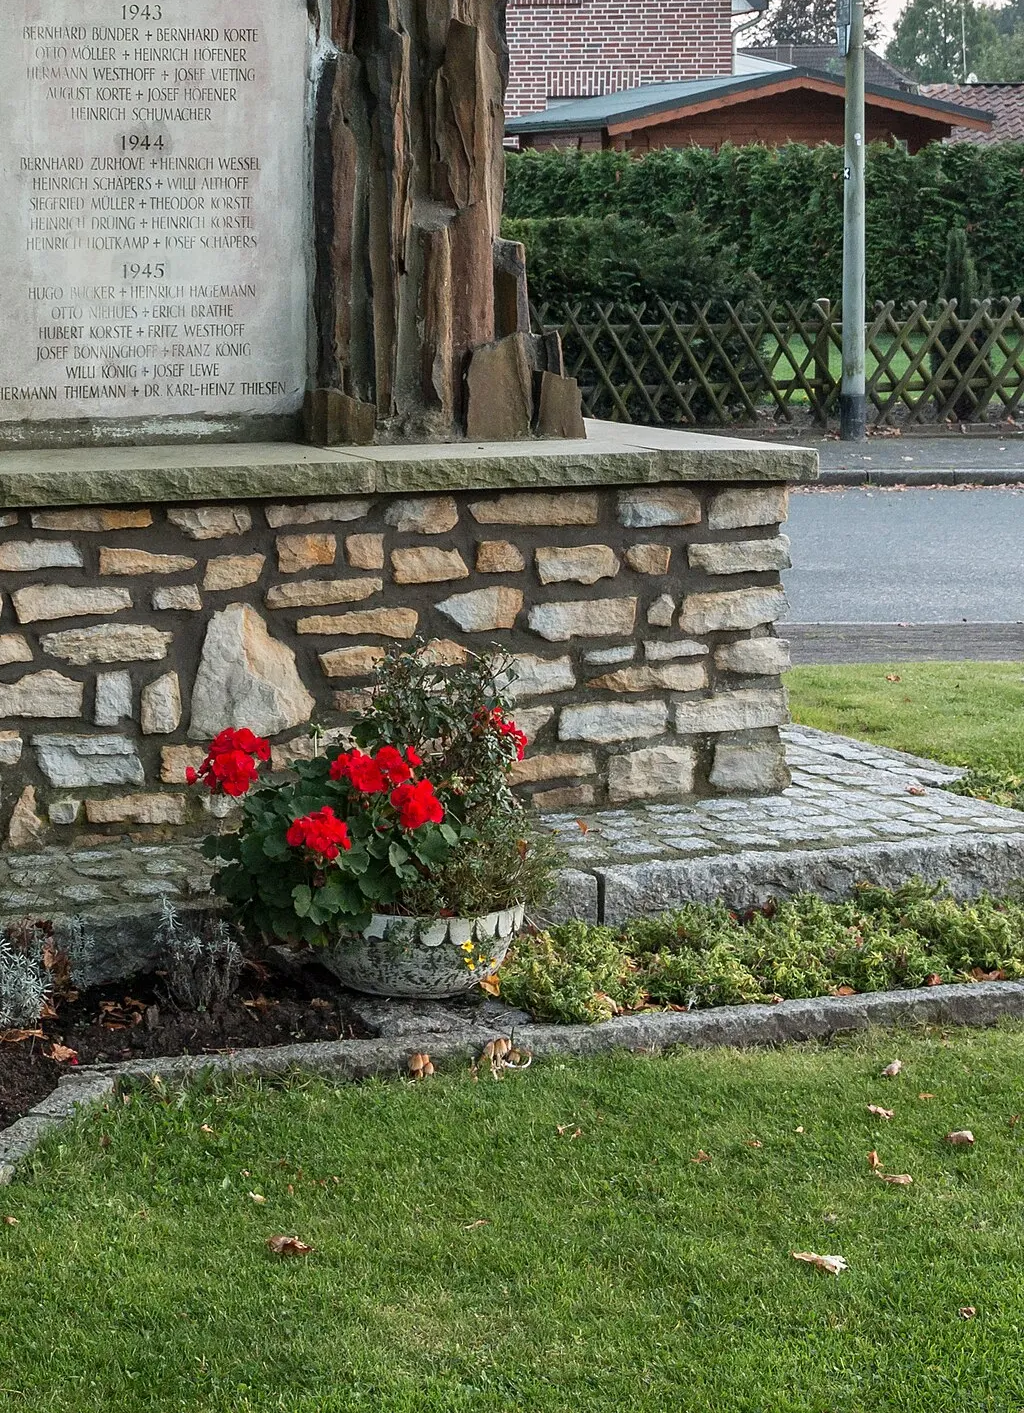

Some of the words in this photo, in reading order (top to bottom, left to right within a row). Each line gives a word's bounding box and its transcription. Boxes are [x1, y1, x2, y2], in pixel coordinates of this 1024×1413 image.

[121, 5, 162, 21] 1943
[23, 27, 87, 41] BERNHARD
[157, 29, 219, 42] BERNHARD
[224, 29, 258, 42] KORTE
[35, 46, 67, 60] OTTO
[71, 46, 116, 60] MÖLLER
[134, 48, 188, 61] HEINRICH
[194, 47, 247, 62] HÖFENER
[26, 67, 87, 81] HERMANN
[93, 67, 155, 81] WESTHOFF
[174, 68, 205, 82] JOSEF
[211, 68, 255, 82] VIETING
[46, 87, 92, 100] AUGUST
[96, 88, 132, 101] KORTE
[147, 88, 179, 102] JOSEF
[184, 87, 237, 101] HÖFENER
[71, 107, 126, 120] HEINRICH
[132, 108, 211, 121] SCHUMACHER
[121, 135, 164, 150] 1944
[20, 157, 83, 171] BERNHARD
[91, 157, 145, 171] ZURHOVE
[160, 157, 213, 171] HEINRICH
[218, 157, 262, 171] WESSEL
[33, 177, 88, 190] HEINRICH
[92, 175, 152, 190] SCHÄPERS
[166, 177, 196, 190] WILLI
[201, 177, 249, 190] ALTHOFF
[29, 197, 84, 210] SIEGFRIED
[91, 194, 135, 210] MÜLLER
[150, 196, 205, 209] THEODOR
[30, 216, 85, 230] HEINRICH
[151, 216, 205, 229] HEINRICH
[165, 236, 196, 249] JOSEF
[122, 264, 166, 279] 1945
[28, 287, 63, 300] HUGO
[130, 285, 184, 298] HEINRICH
[190, 285, 256, 298] HAGEMANN
[51, 306, 83, 319] OTTO
[89, 305, 138, 318] NIEHUES
[152, 305, 185, 318] ERICH
[191, 305, 233, 317] BRATHE
[39, 326, 83, 339] HUBERT
[89, 325, 133, 338] KORSTE
[148, 325, 177, 338] FRITZ
[184, 324, 245, 337] WESTHOFF
[36, 346, 68, 361] JOSEF
[172, 344, 209, 357] FRANZ
[215, 341, 251, 357] KÖNIG
[66, 366, 95, 379] WILLI
[101, 363, 137, 378] KÖNIG
[153, 365, 185, 379] JOSEF
[190, 364, 219, 377] LEWE
[64, 386, 126, 399] THIEMANN
[144, 384, 162, 397] DR.
[166, 383, 235, 396] KARL-HEINZ
[241, 381, 286, 395] THIESEN
